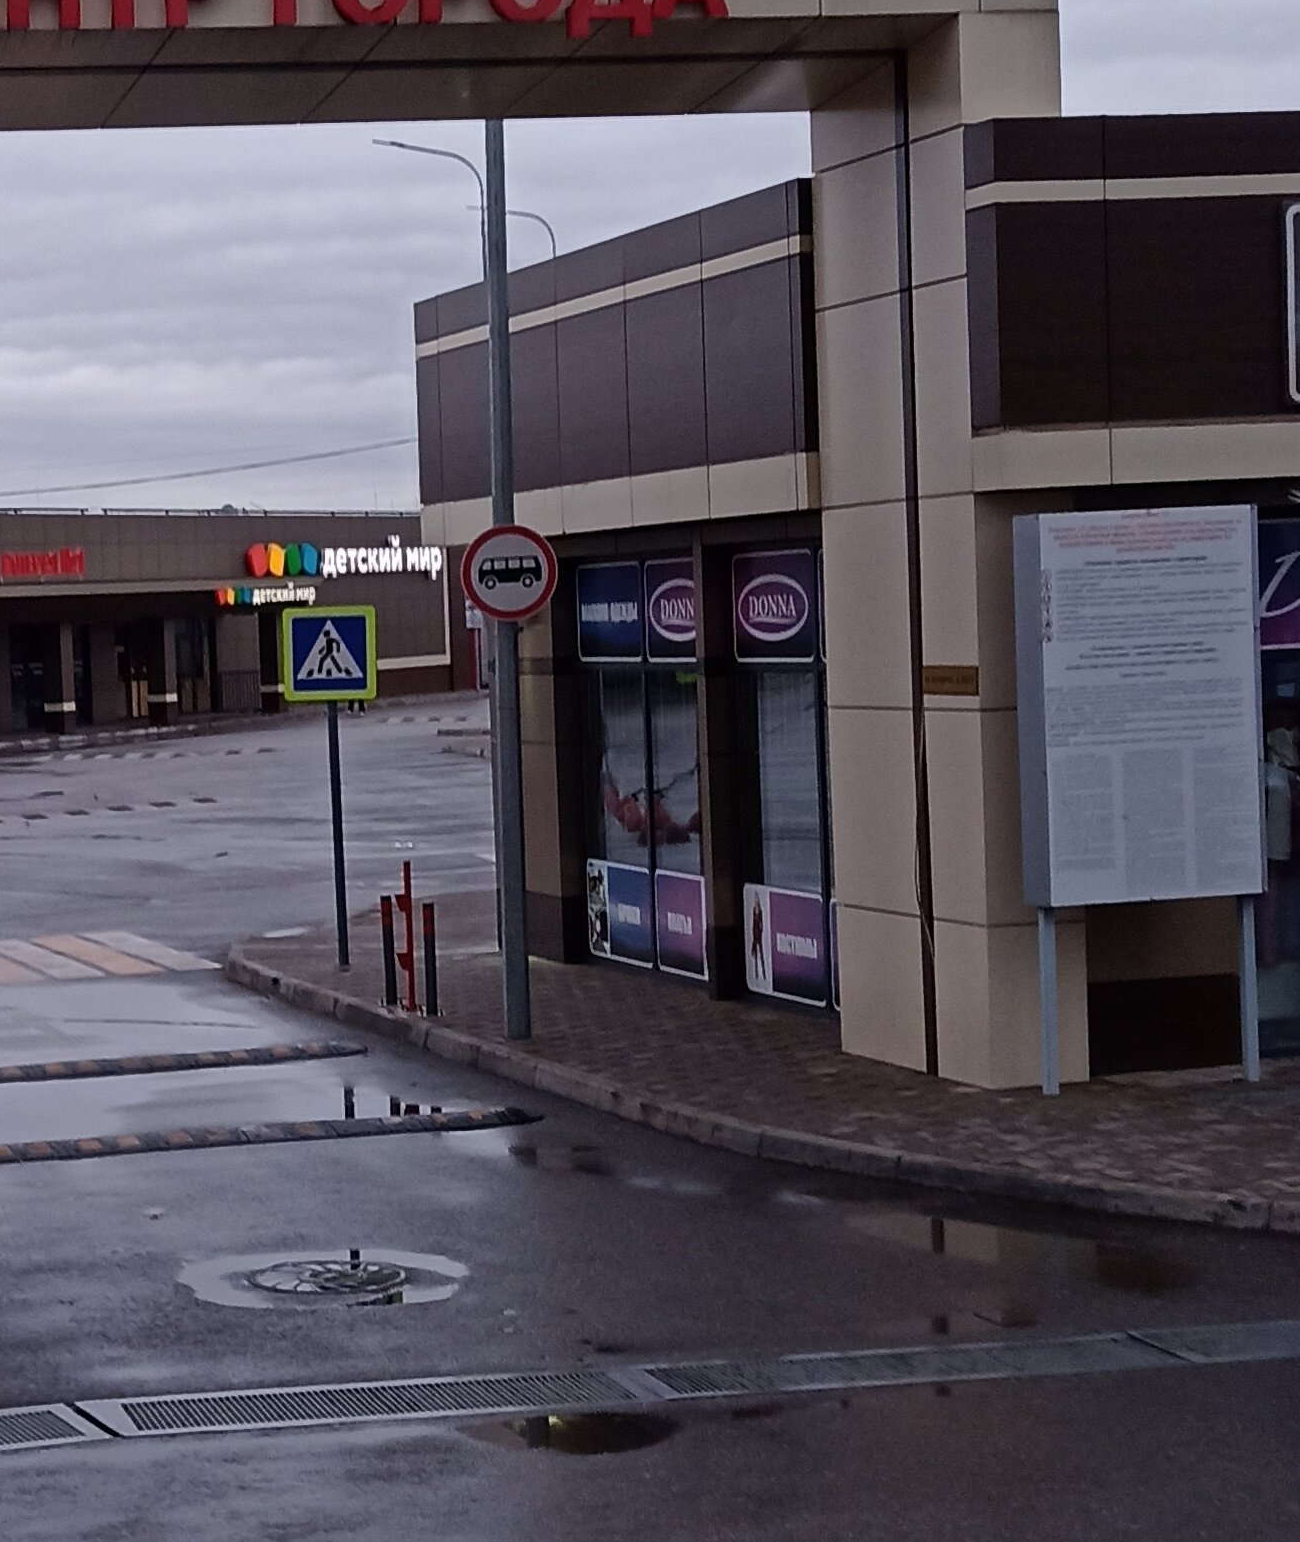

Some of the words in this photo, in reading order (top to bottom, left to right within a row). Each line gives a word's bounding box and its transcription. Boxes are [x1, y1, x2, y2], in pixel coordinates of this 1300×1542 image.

[321, 534, 402, 579] детский
[405, 545, 442, 580] мир
[252, 581, 295, 605] детский
[296, 586, 316, 605] мир
[660, 598, 695, 620] DONN
[749, 593, 797, 618] DONNA
